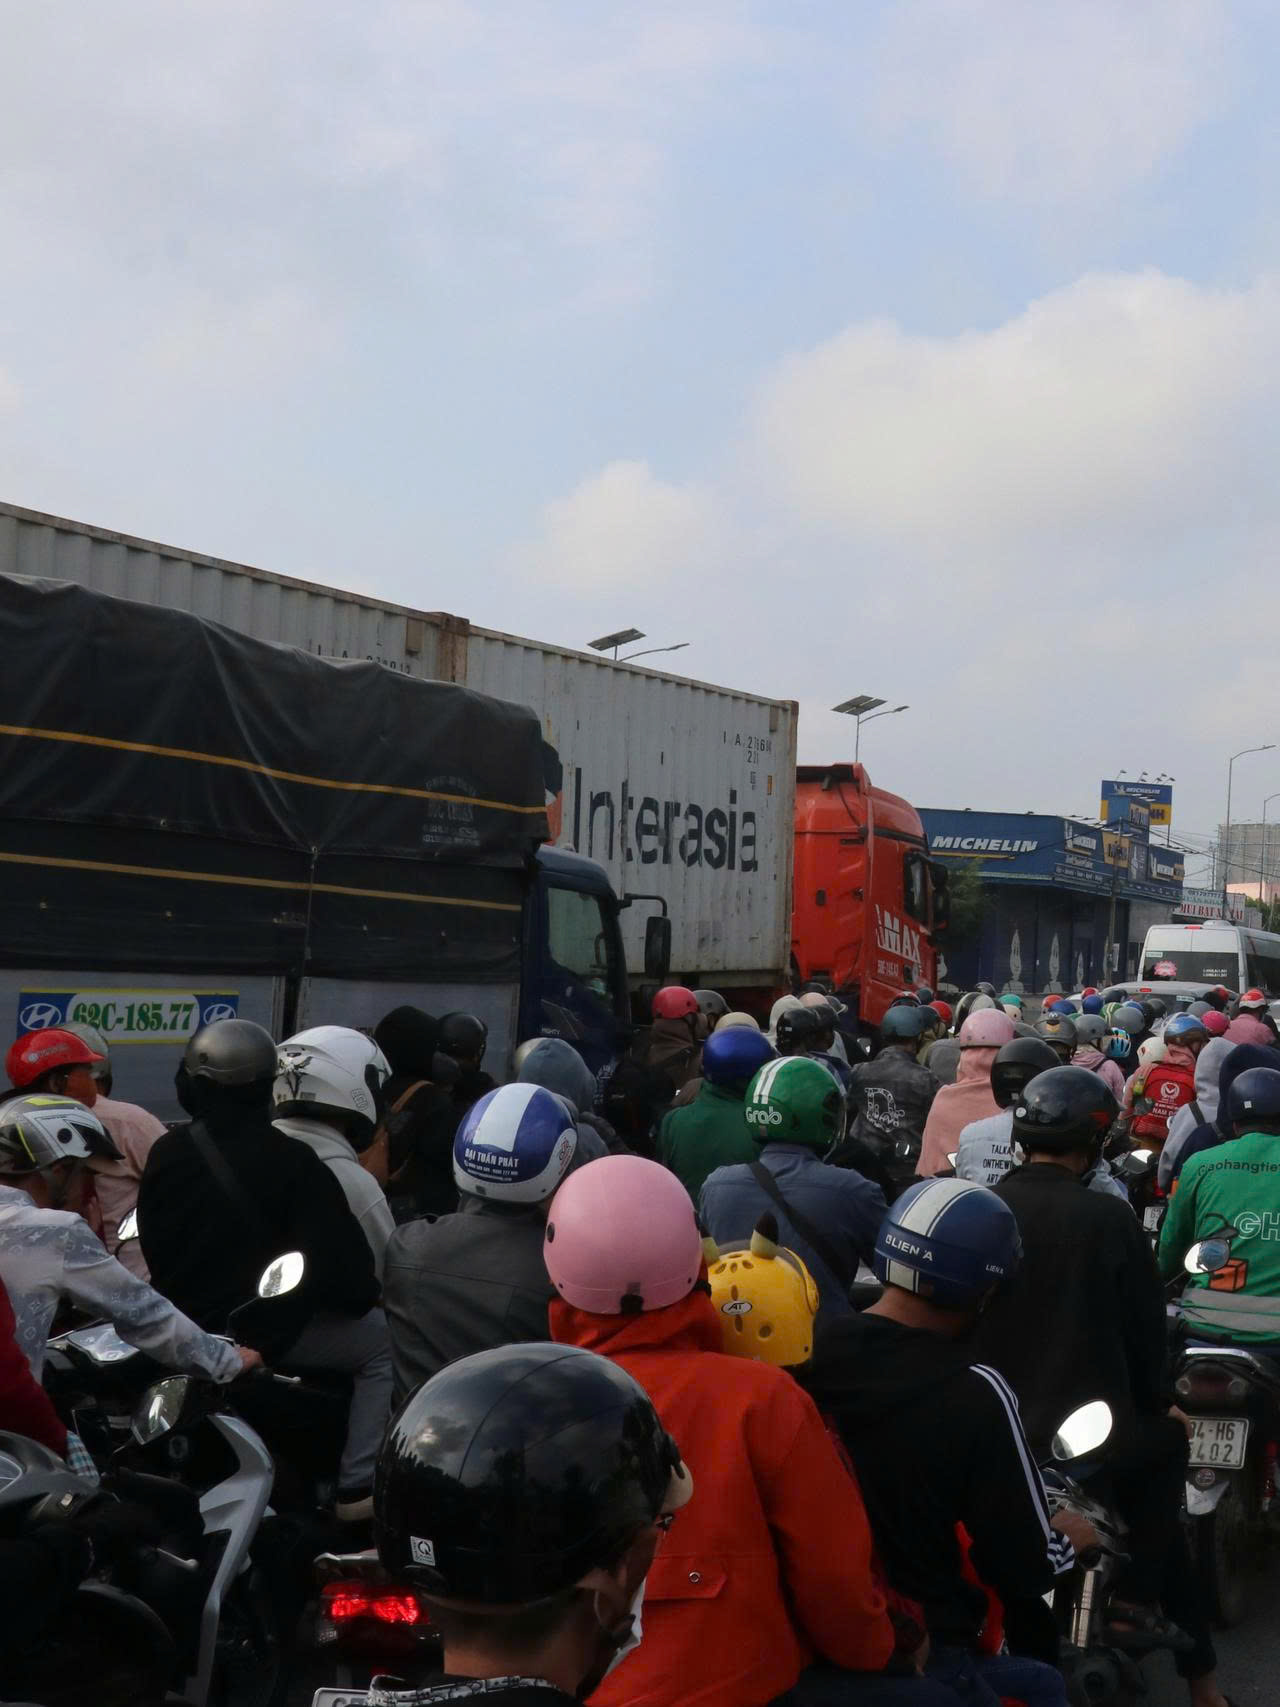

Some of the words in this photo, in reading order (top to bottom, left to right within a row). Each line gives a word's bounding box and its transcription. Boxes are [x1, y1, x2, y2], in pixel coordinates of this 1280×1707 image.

[573, 767, 758, 873] Interasia
[931, 835, 1039, 853] MICHELIN
[72, 1002, 194, 1032] 62C-185.77
[745, 1105, 783, 1125] Grab
[1190, 1440, 1233, 1463] 402
